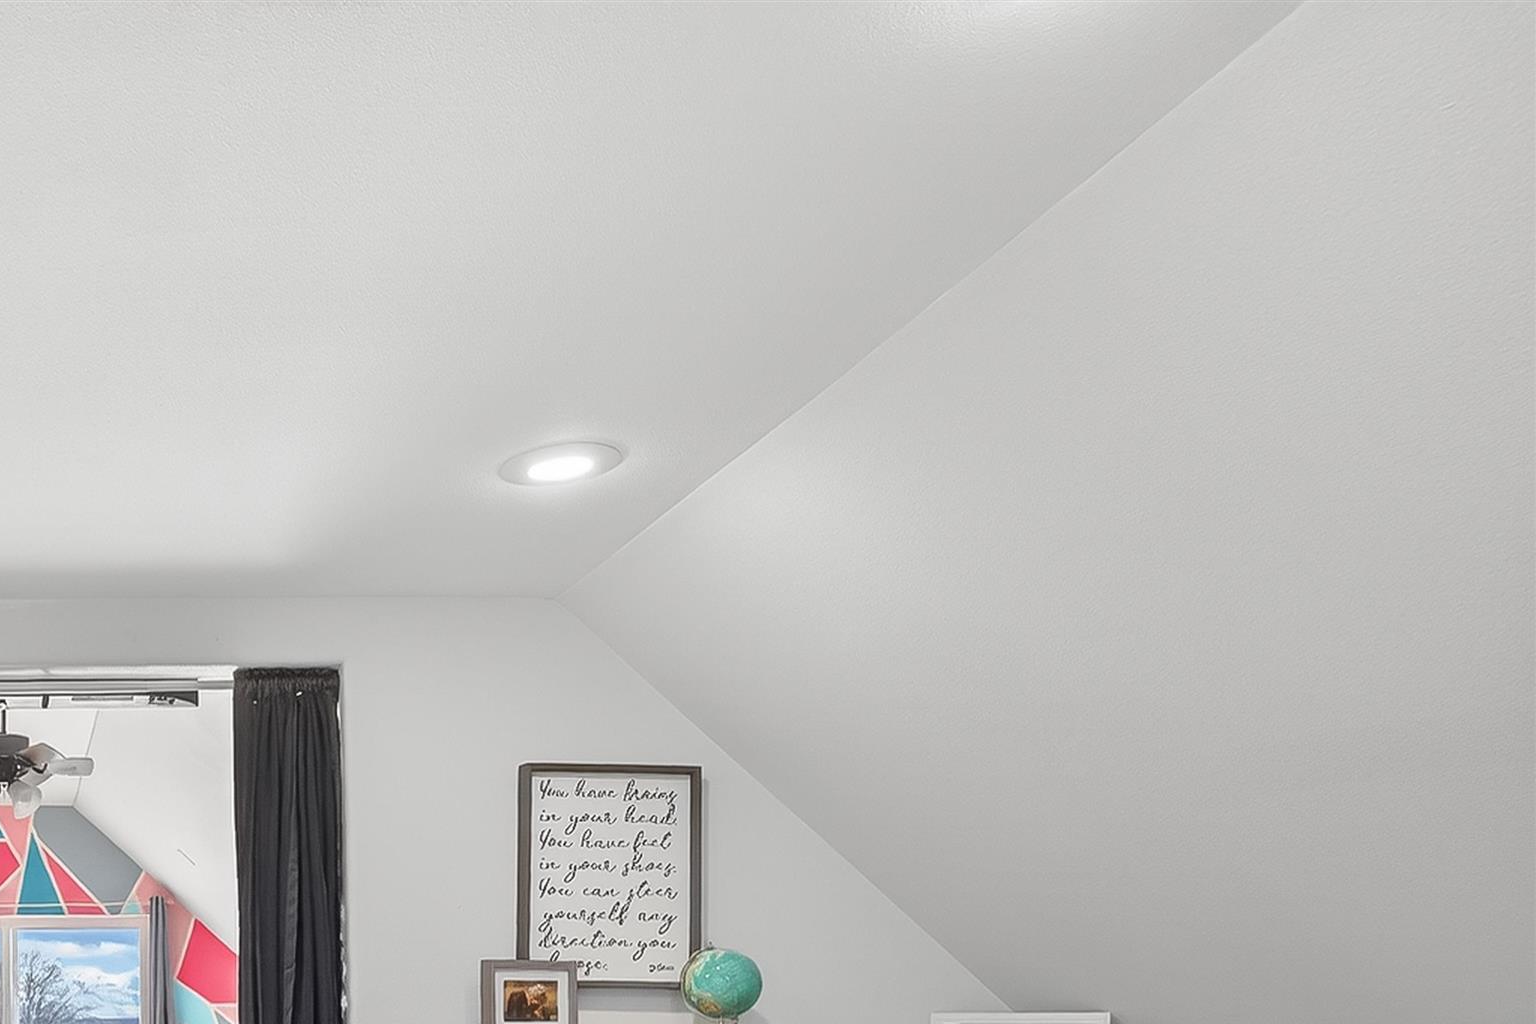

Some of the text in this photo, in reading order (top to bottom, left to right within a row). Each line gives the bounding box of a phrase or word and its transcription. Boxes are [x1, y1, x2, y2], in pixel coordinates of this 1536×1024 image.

[539, 779, 677, 805] You have brains
[539, 809, 562, 821] in
[564, 812, 617, 835] your
[539, 828, 672, 852] You have feet
[539, 857, 561, 870] in
[564, 860, 616, 883] your
[539, 877, 678, 903] You can steer
[538, 901, 678, 935] yourself any
[538, 926, 677, 961] direction you
